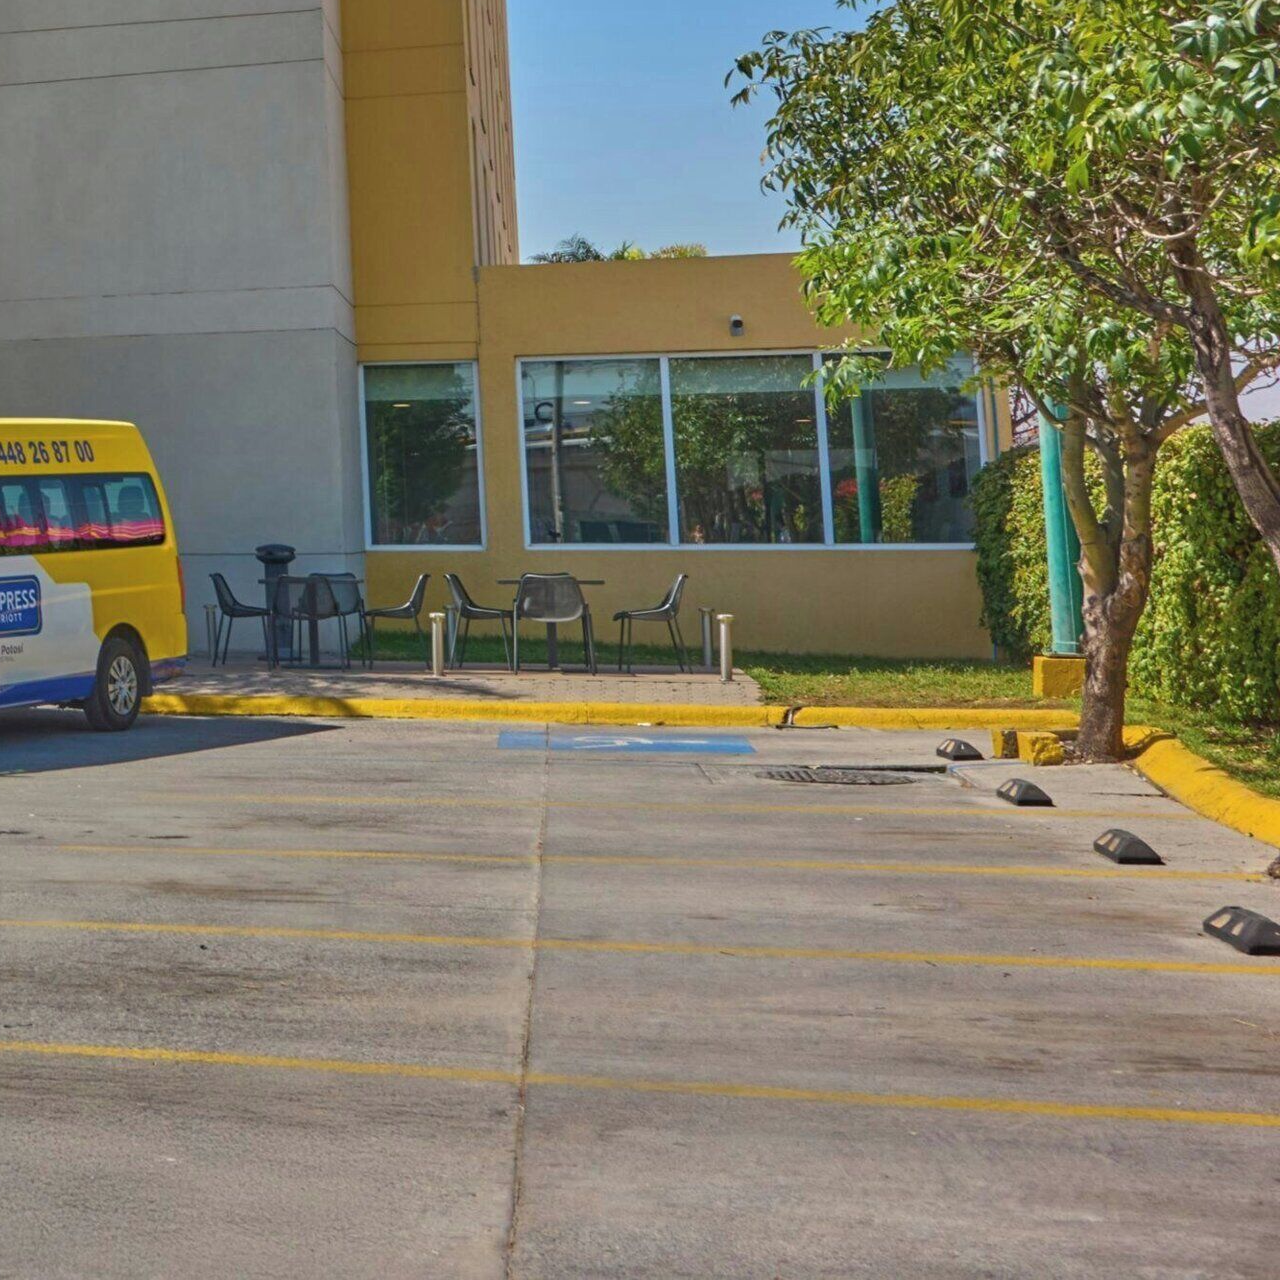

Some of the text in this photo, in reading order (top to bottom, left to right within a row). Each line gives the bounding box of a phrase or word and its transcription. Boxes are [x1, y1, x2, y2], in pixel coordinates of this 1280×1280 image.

[28, 440, 50, 464] 26
[51, 440, 70, 463] 87
[73, 439, 95, 463] 00
